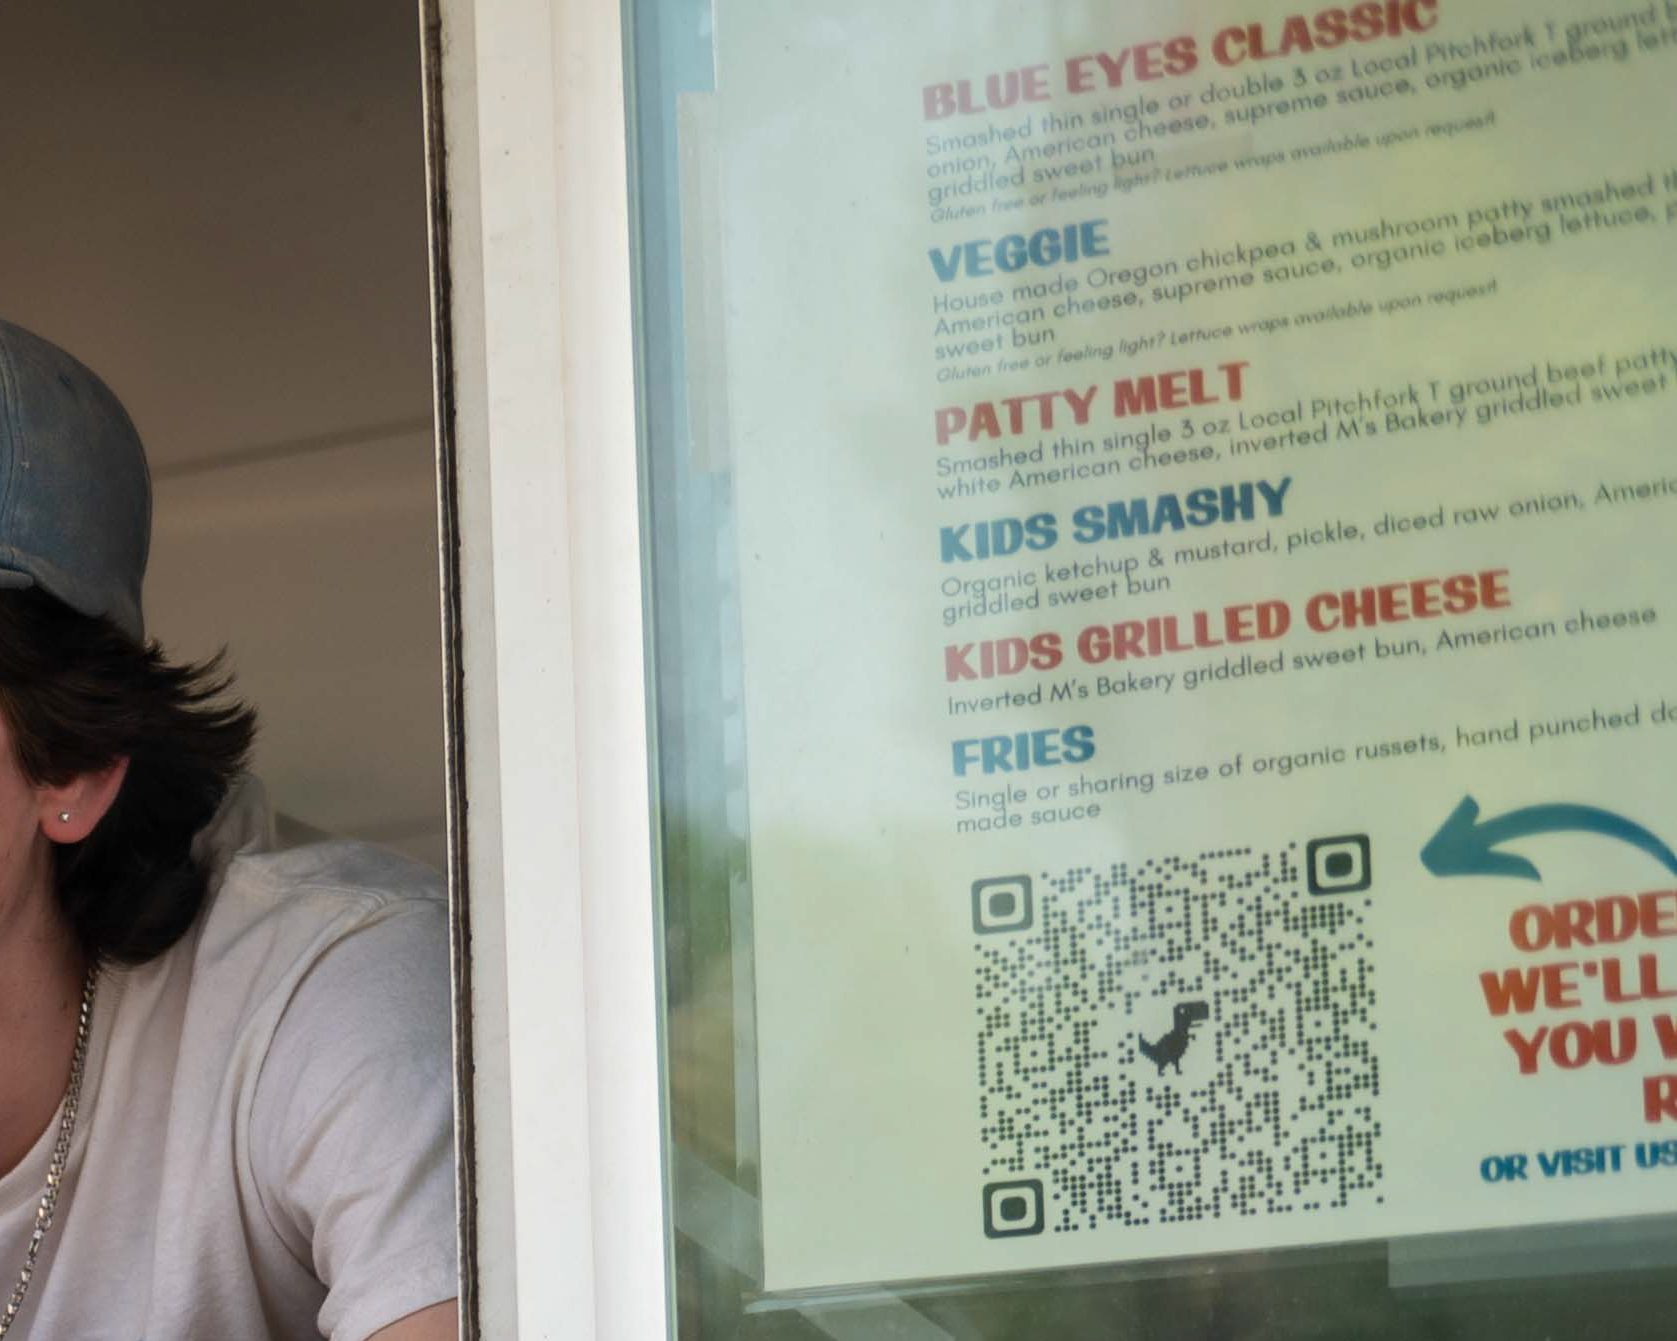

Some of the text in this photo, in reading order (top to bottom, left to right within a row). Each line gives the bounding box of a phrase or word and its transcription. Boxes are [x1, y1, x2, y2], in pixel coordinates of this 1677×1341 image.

[922, 0, 1438, 121] BLUE EYES CLASSIC
[928, 219, 1110, 283] VEGGIE
[934, 361, 1250, 445] PATTY MELT
[936, 444, 1043, 477] Smashed
[1053, 434, 1094, 459] thin
[1103, 422, 1171, 452] single
[1181, 419, 1195, 438] 3
[1203, 417, 1229, 435] oz
[1239, 401, 1302, 430] Local
[1311, 384, 1419, 420] Pitchfork
[1427, 382, 1441, 400] T
[1449, 365, 1538, 404] ground
[1547, 355, 1605, 383] beef
[937, 373, 1666, 499] white American cheese, inverted M's Bakery griddled sweet
[940, 476, 1292, 563] KIDS SMASHY
[942, 570, 1036, 600] Organic
[1045, 556, 1139, 585] ketchup
[1148, 549, 1164, 567] &
[1174, 533, 1278, 564] mustard,
[1287, 520, 1365, 553] pickle,
[1374, 505, 1443, 536] diced
[1453, 505, 1499, 524] raw
[1509, 491, 1583, 517] onion,
[942, 573, 1170, 626] griddled sweet bun
[944, 568, 1511, 683] KIDS GRILLED CHEESE
[949, 607, 1657, 716] Inverted M's Bakery griddled sweet bun, American cheese
[952, 725, 1095, 777] FRIES
[956, 784, 1027, 811] Single
[1037, 784, 1060, 801] or
[1069, 771, 1154, 799] sharing
[1163, 763, 1209, 785] size
[1219, 755, 1242, 776] of
[1253, 744, 1345, 775] organic
[1355, 733, 1446, 760] russets,
[1456, 720, 1519, 747] hand
[1529, 704, 1639, 745] punched
[956, 804, 1101, 833] made sauce
[1479, 954, 1677, 1016] WE'LL
[1504, 1017, 1637, 1075] YOU
[1480, 1153, 1527, 1183] OR
[1537, 1143, 1626, 1177] VISIT
